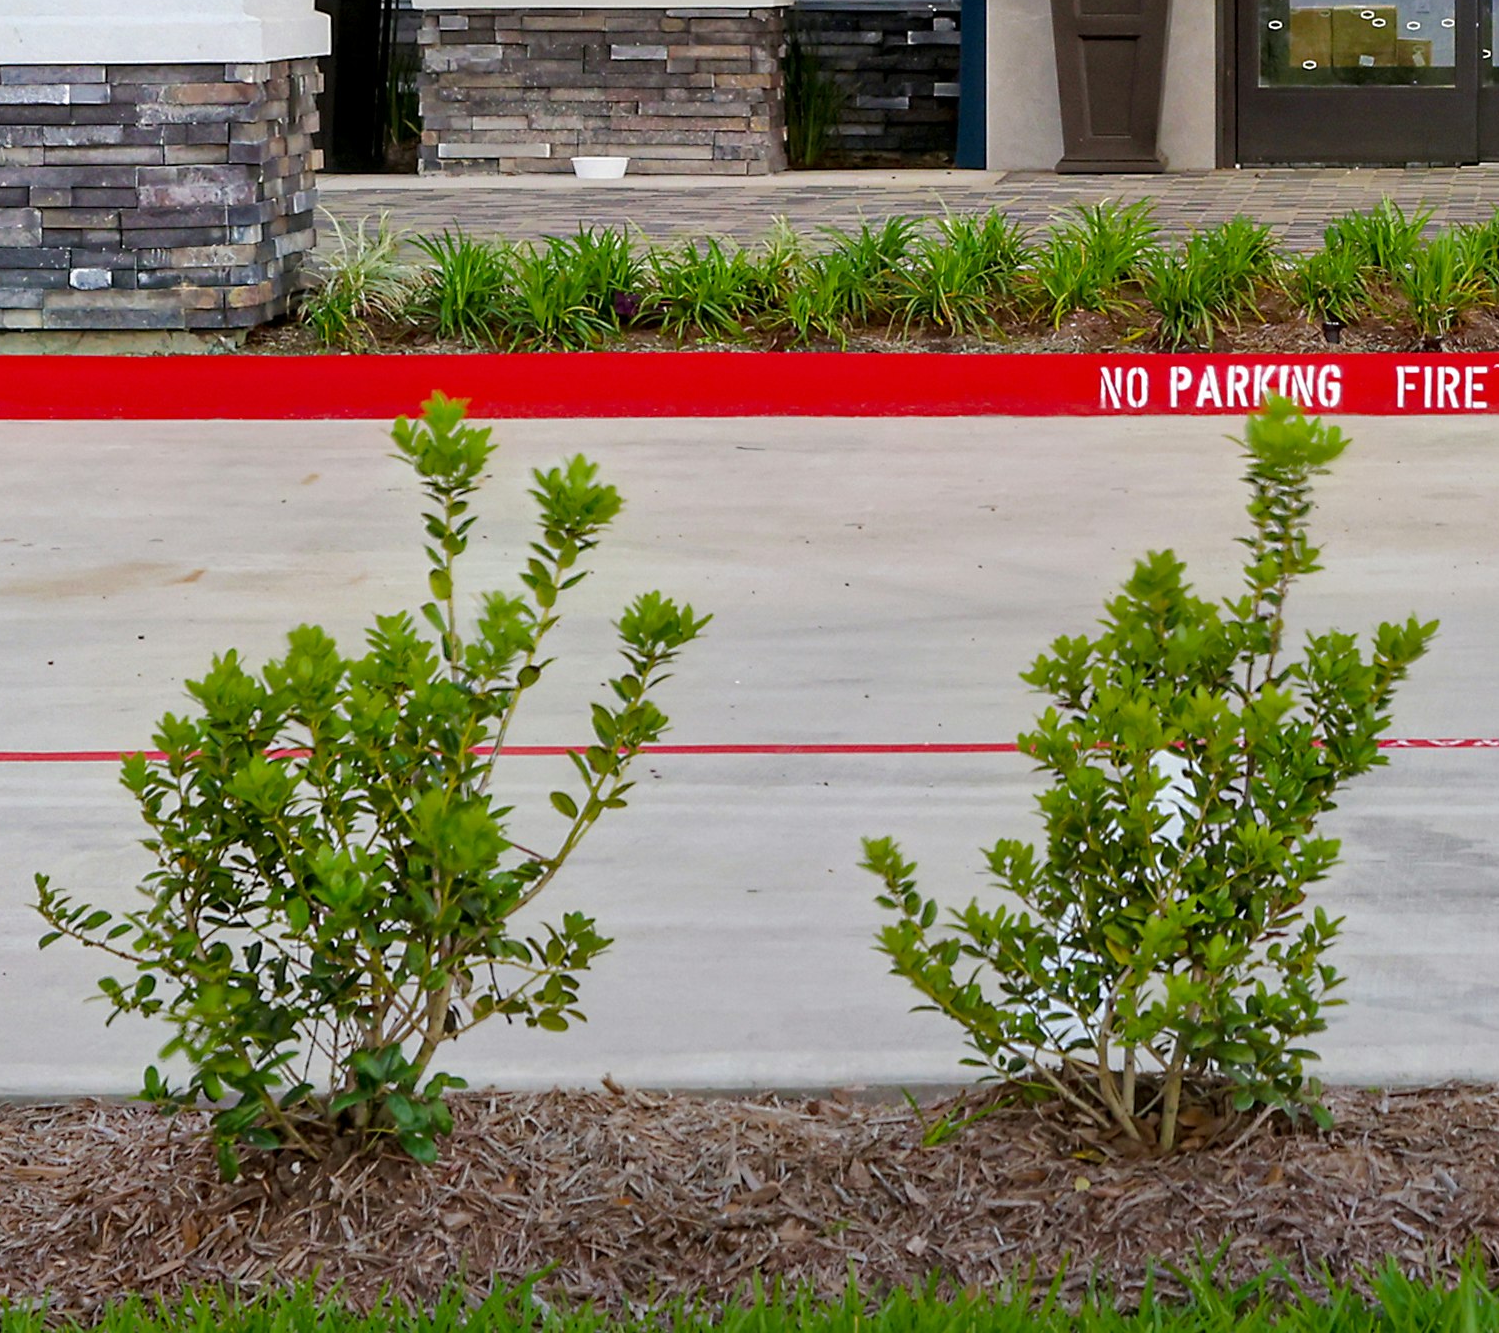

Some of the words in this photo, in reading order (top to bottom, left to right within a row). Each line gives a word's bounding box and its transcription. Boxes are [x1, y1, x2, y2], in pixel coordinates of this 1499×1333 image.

[1100, 366, 1149, 409] NO
[1169, 364, 1343, 408] PARKING
[1396, 366, 1489, 408] FIRE
